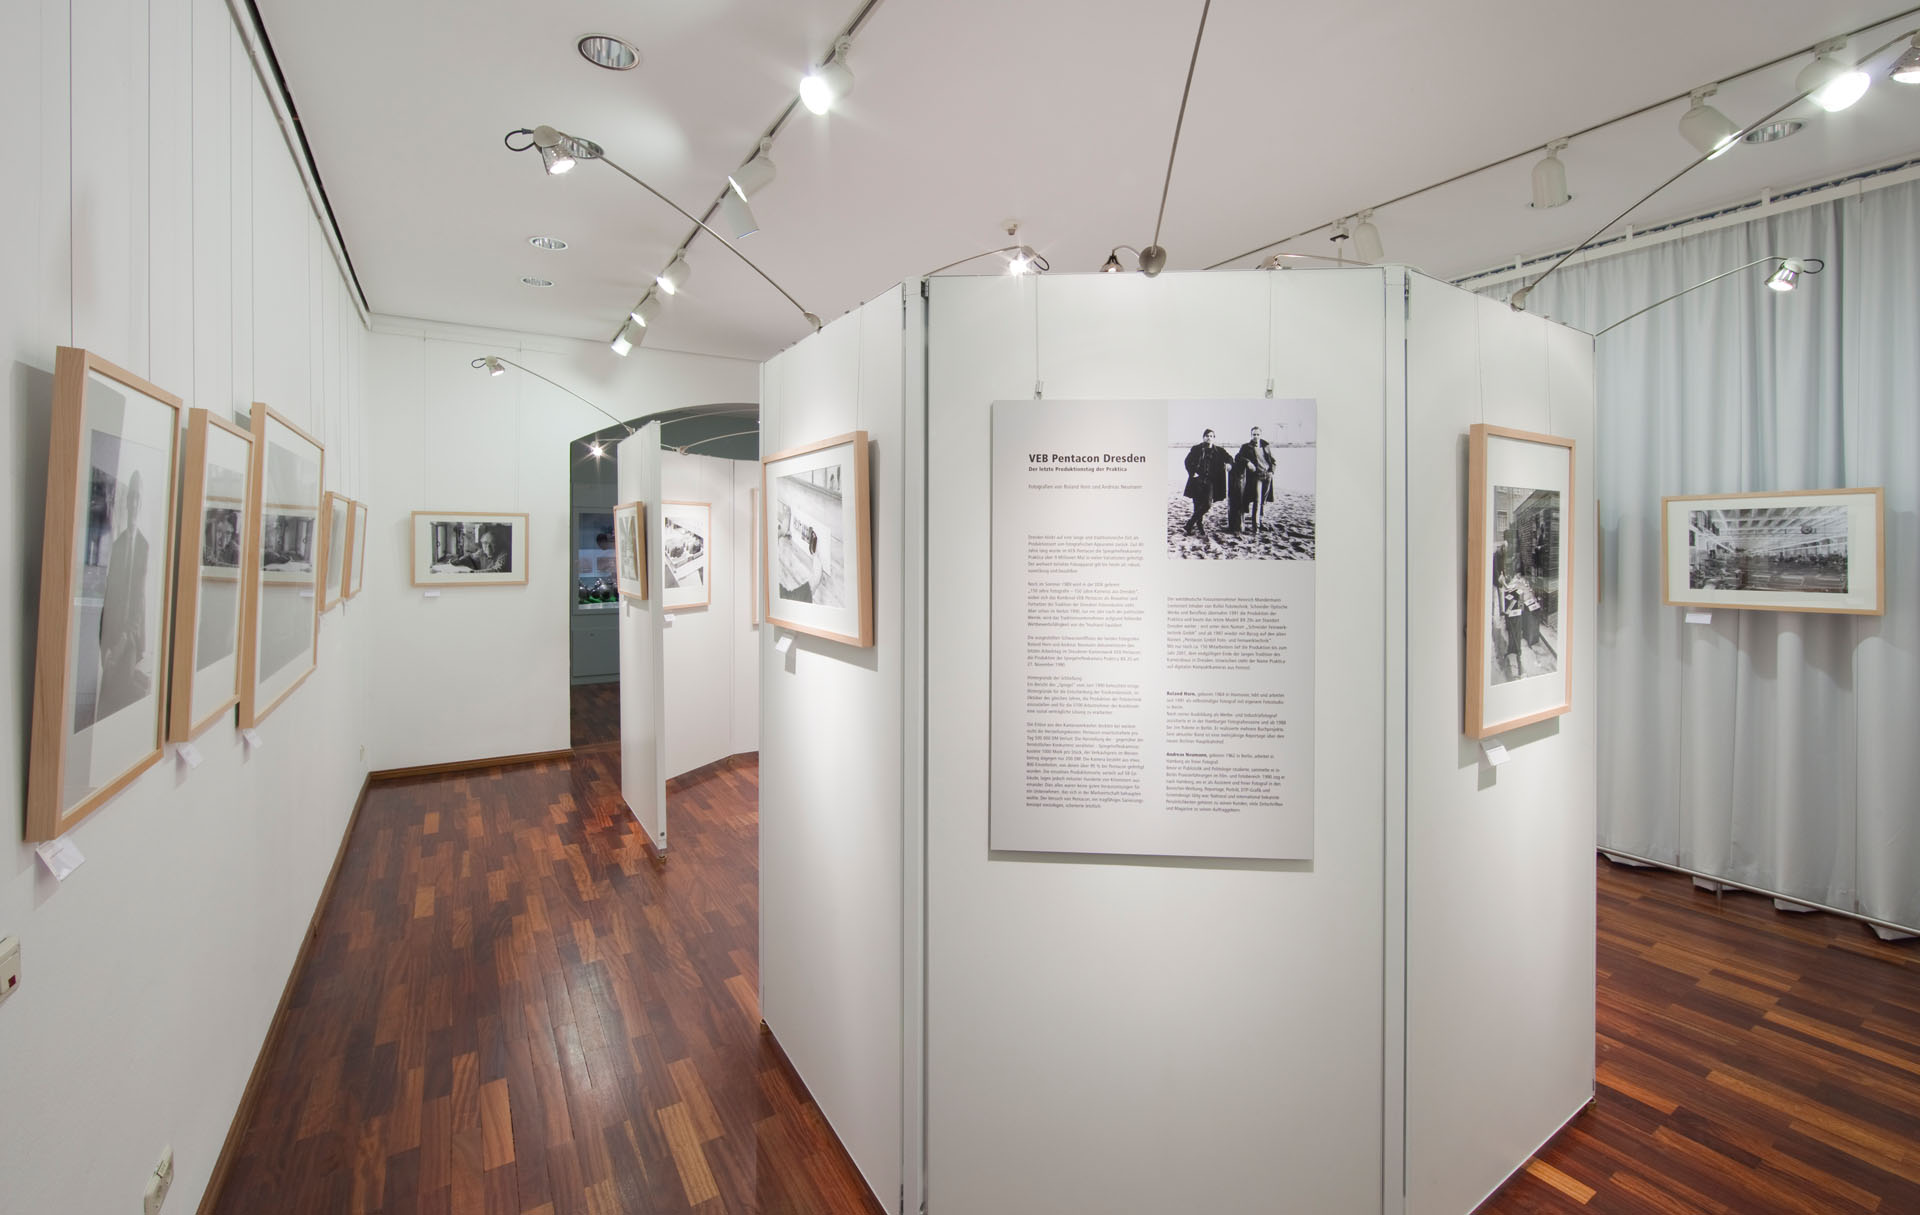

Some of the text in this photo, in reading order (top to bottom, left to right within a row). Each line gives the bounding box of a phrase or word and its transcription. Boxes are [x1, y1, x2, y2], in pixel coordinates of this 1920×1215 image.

[1028, 453, 1146, 463] VEB Pentacon Dresden
